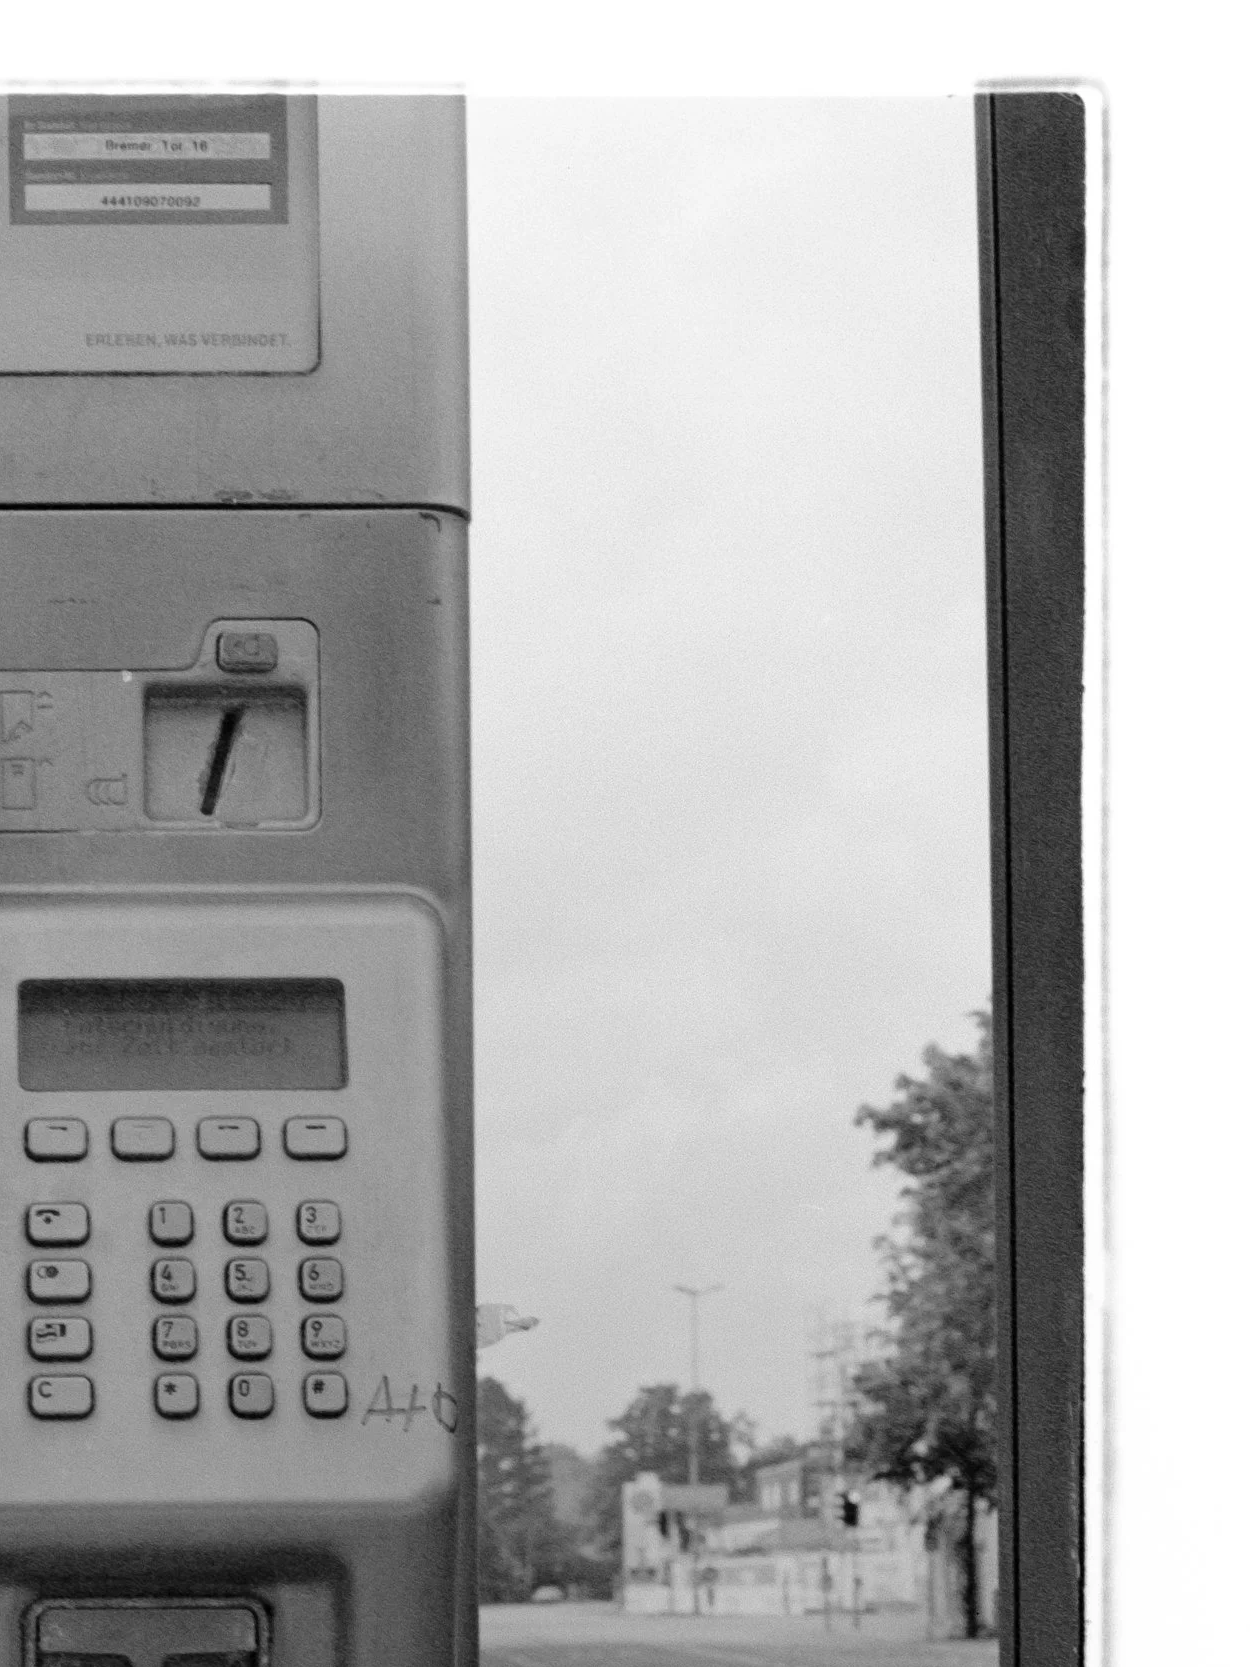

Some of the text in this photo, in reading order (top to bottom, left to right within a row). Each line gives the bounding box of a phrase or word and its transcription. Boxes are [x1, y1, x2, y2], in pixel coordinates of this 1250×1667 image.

[164, 333, 198, 347] WAS
[158, 1206, 167, 1225] 1
[233, 1206, 245, 1224] 2
[305, 1206, 317, 1224] 3
[161, 1264, 173, 1281] 4
[235, 1264, 247, 1281] 5
[309, 1263, 320, 1281] 6
[162, 1321, 174, 1338] 7
[237, 1321, 249, 1338] 8
[311, 1321, 323, 1338] 9
[38, 1381, 53, 1398] C
[238, 1380, 250, 1397] 0
